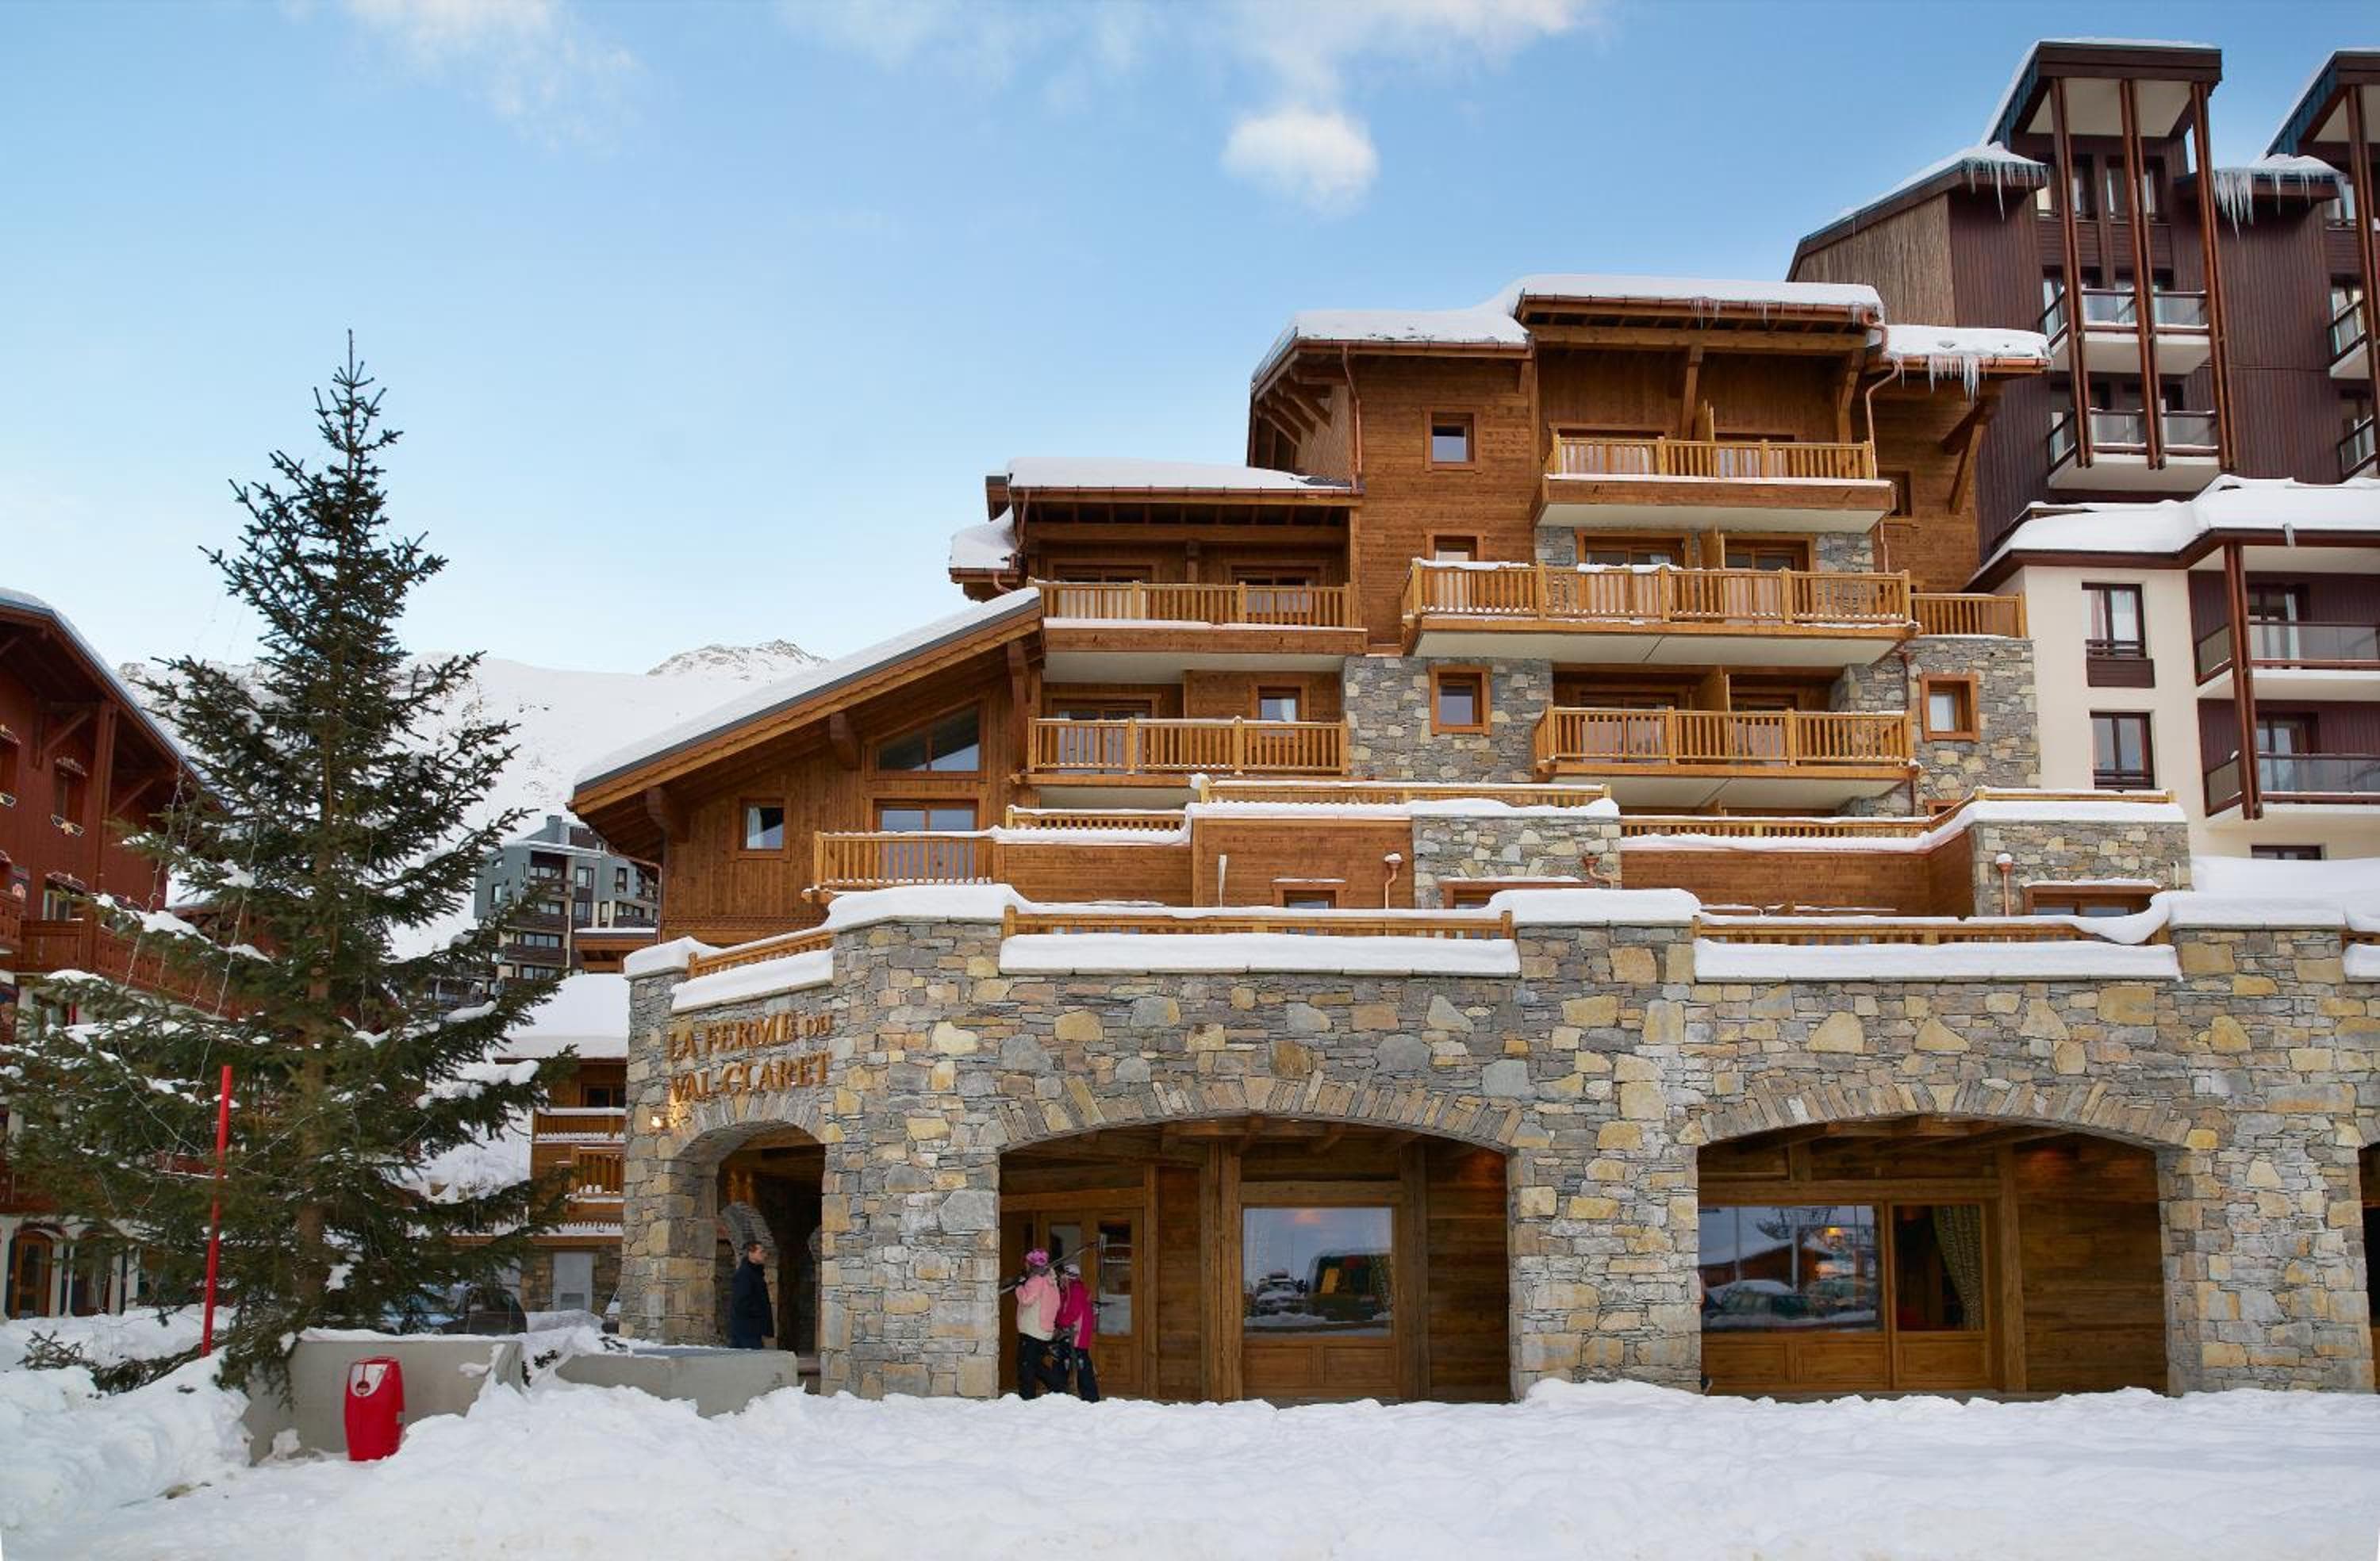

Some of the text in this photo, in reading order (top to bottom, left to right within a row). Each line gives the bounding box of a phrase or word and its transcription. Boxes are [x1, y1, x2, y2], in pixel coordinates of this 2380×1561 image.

[667, 1030, 697, 1061] LA
[704, 1011, 797, 1053] FERME
[670, 1052, 832, 1103] VAL CLARET
